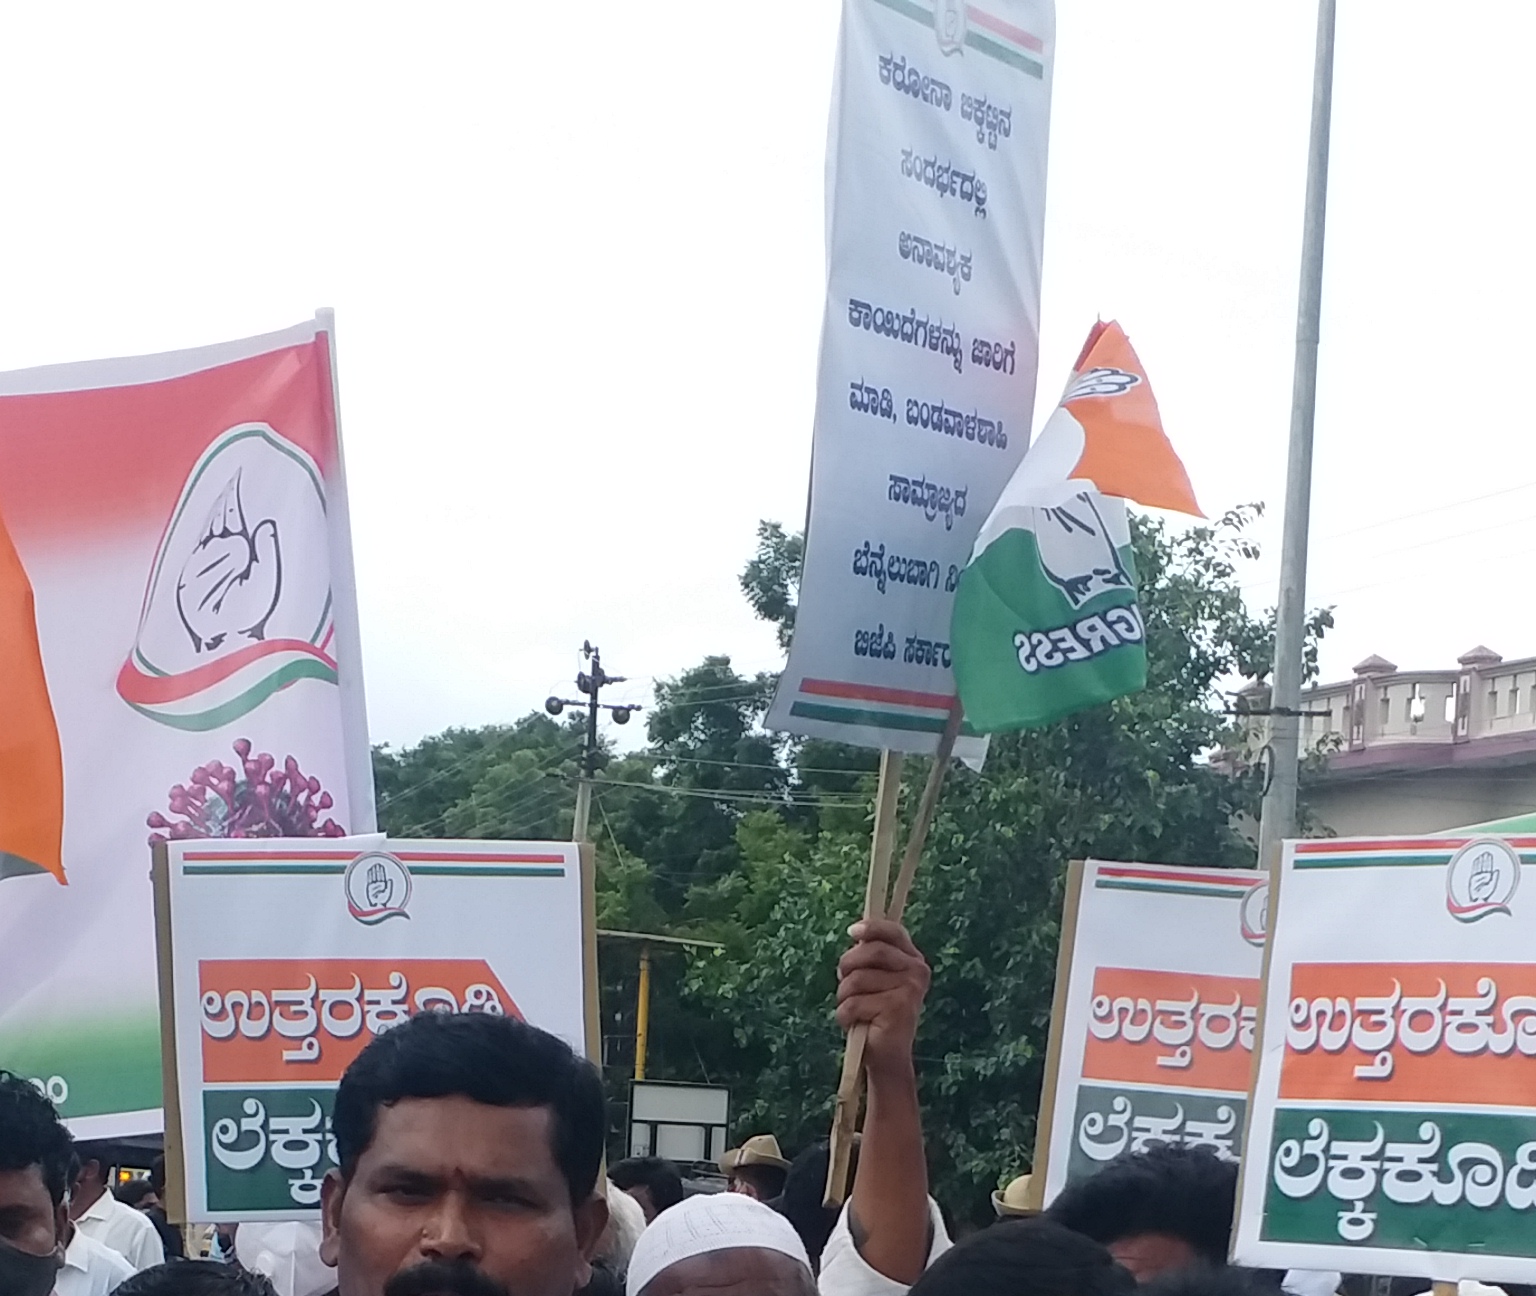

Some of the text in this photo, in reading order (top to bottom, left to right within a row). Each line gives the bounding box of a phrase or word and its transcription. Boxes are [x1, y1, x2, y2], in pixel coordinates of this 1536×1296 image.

[901, 147, 987, 219] ಸಂದರ್ಭದಲ್ಲಿ
[899, 231, 972, 296] ಅನಾವಶ್ಯಕ
[848, 299, 1016, 375] ಕಾಯಿದೆಗಳನ್ನು ಜಾರಿಗೆ
[849, 377, 1007, 449] ಮಾಡಿ, ಬಂಡವಾಳಶಾಹಿ
[888, 473, 968, 531] ಸಾಮ್ರಾಜ್ಯದ
[854, 623, 896, 663] ಬಿಜೆಪಿ
